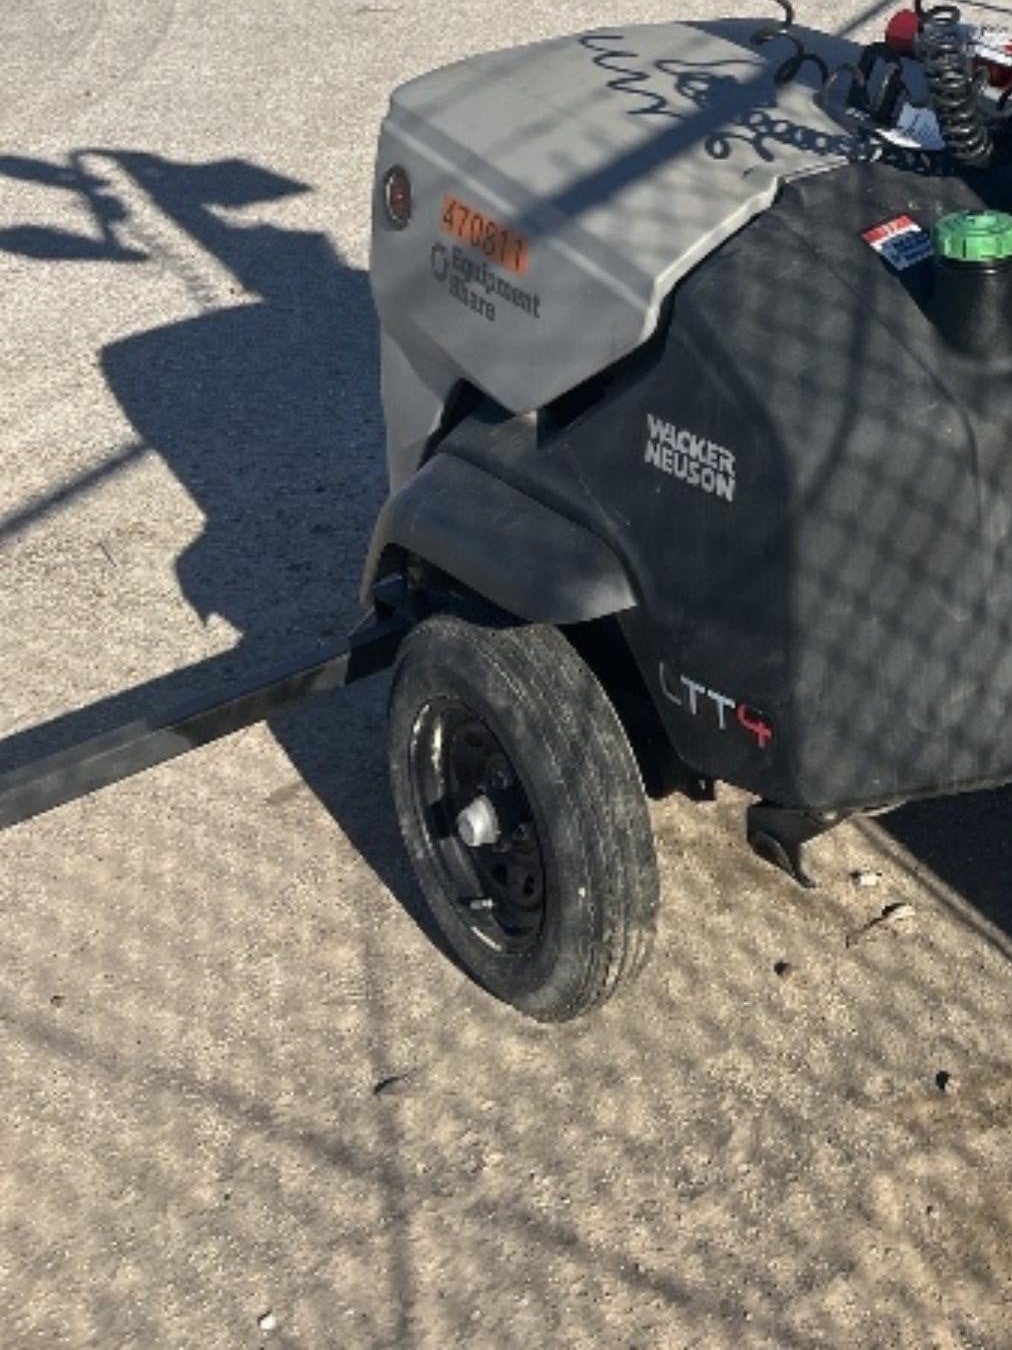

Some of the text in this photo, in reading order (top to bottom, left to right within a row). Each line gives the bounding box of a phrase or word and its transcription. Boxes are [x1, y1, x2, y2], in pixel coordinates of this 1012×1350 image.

[644, 439, 736, 502] NEUSON
[646, 412, 736, 479] WACKER
[659, 661, 771, 748] LTT4
